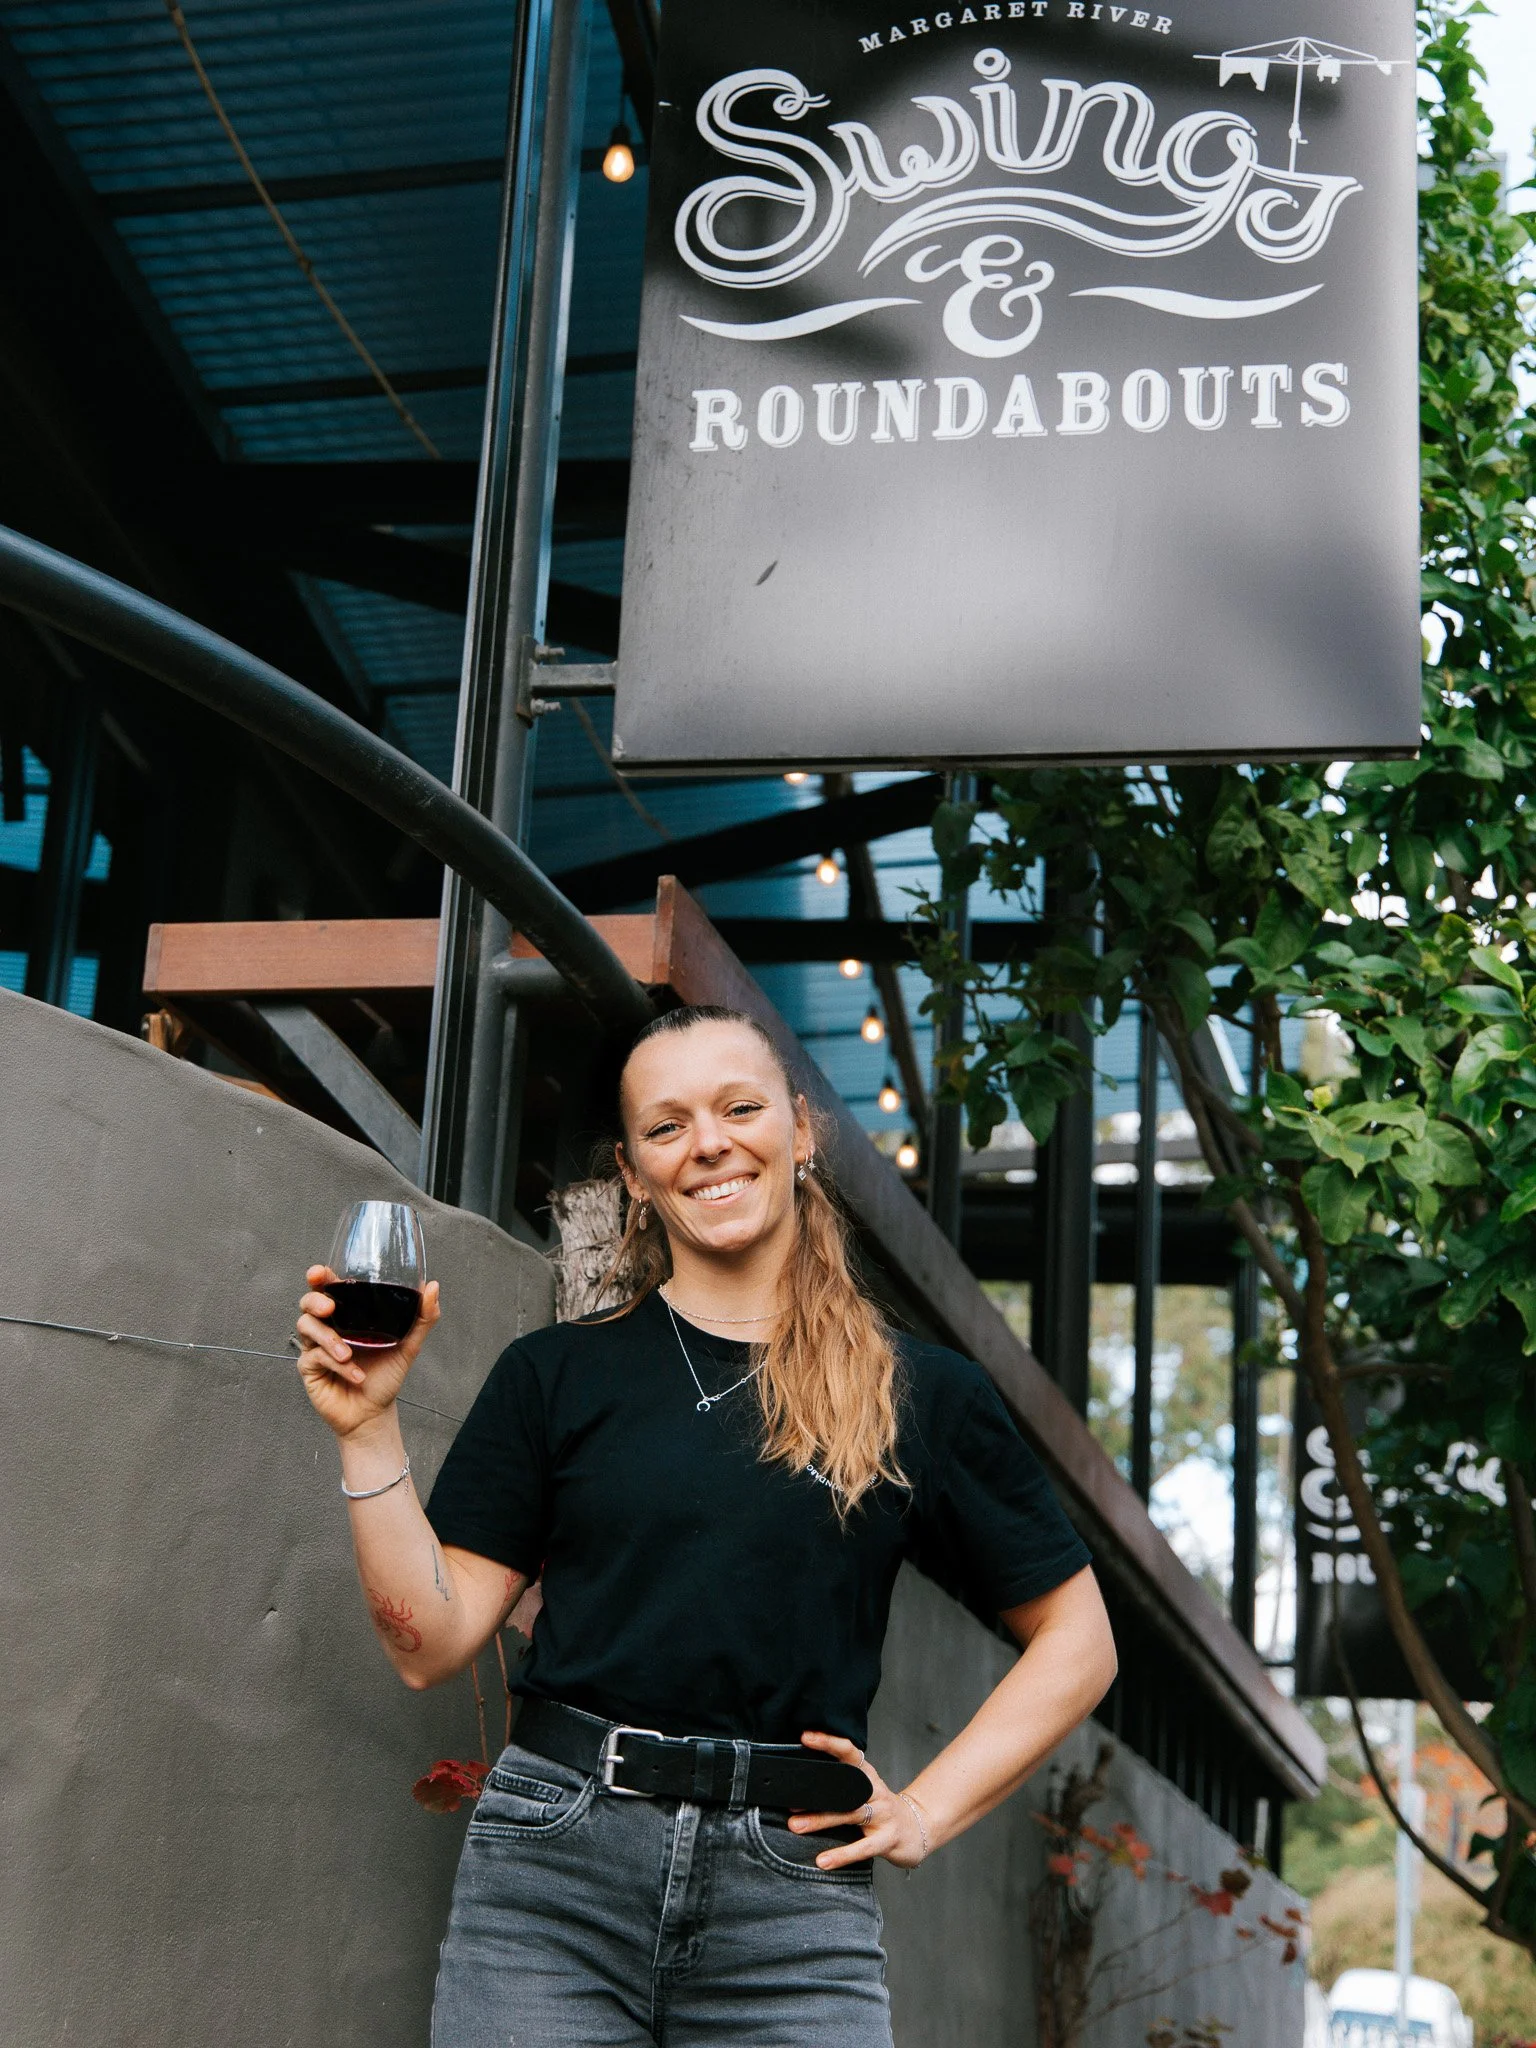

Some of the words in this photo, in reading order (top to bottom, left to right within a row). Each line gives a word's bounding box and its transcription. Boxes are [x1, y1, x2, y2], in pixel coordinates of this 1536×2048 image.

[858, 1, 1048, 53] MARGARET
[1067, 1, 1173, 34] RIVER
[904, 234, 1055, 359] &
[689, 362, 1351, 453] ROUNDABOUTS
